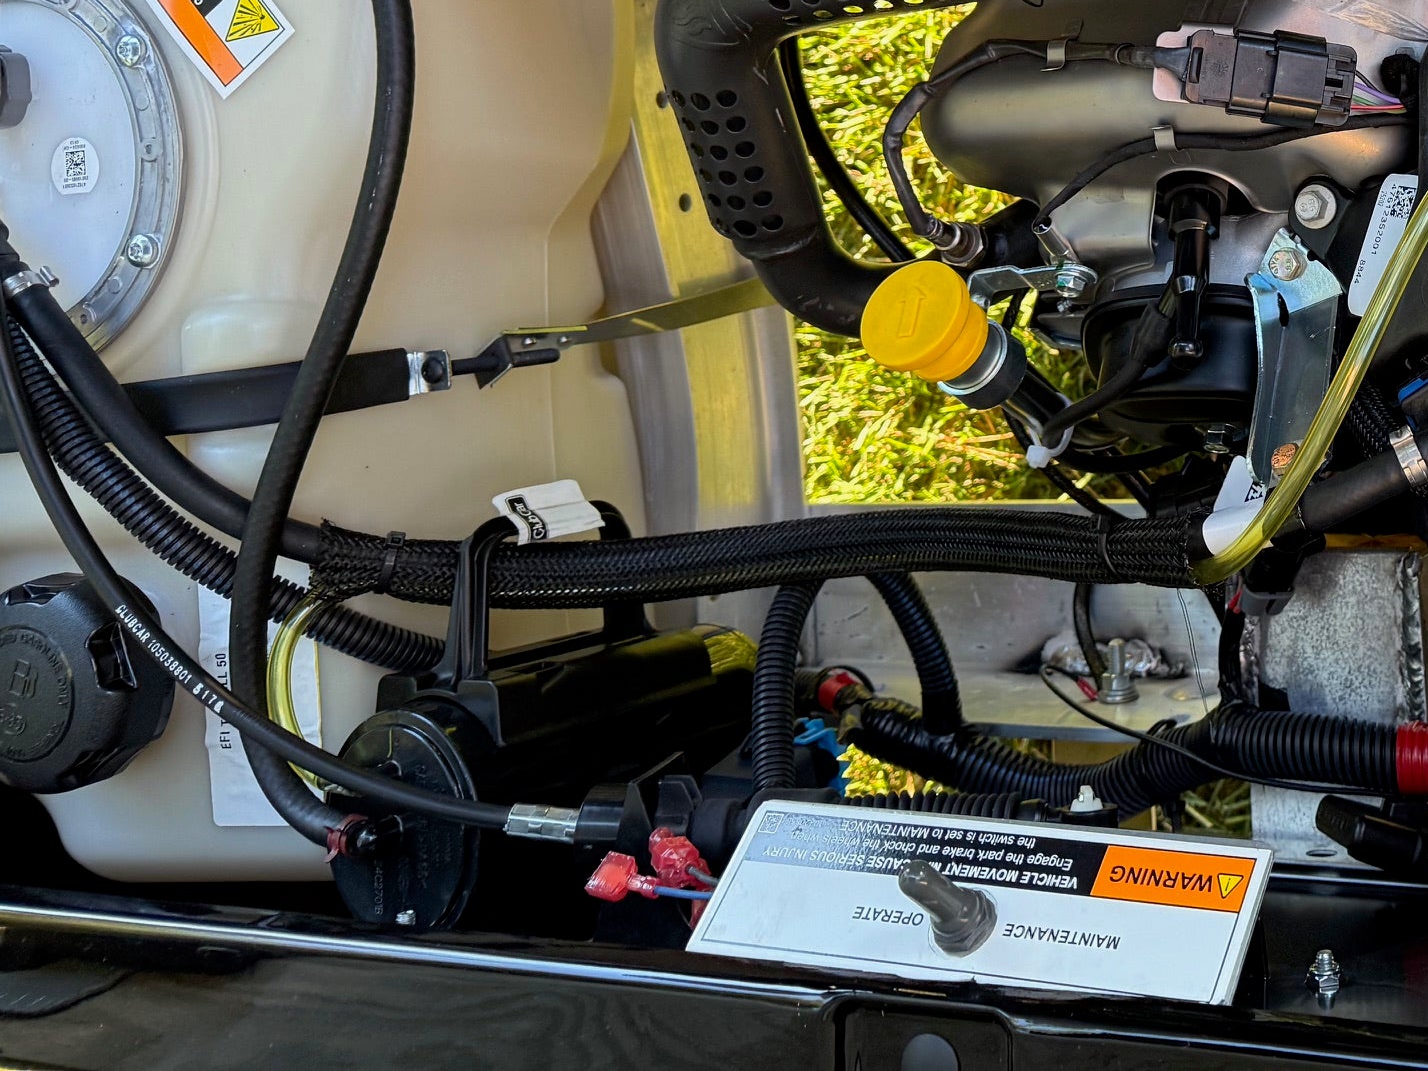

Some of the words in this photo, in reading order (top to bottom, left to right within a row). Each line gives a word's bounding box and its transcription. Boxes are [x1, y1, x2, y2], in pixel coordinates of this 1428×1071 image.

[1354, 259, 1366, 284] 8844
[115, 604, 149, 642] CLUBCAR
[148, 639, 192, 684] 105038801
[215, 653, 227, 667] 50
[219, 732, 232, 749] EFI
[838, 820, 929, 838] MAINTENANCE
[930, 828, 944, 839] to
[944, 830, 964, 841] set
[964, 831, 976, 843] is
[977, 833, 1015, 846] switch
[1016, 836, 1036, 848] the
[762, 845, 808, 859] INJURY
[806, 849, 865, 866] SERIOUS
[864, 855, 906, 870] CAUSE
[942, 863, 1019, 882] MOVEMENT
[1019, 871, 1078, 888] VEHICLE
[1108, 865, 1214, 892] WARNING
[851, 906, 925, 925] OPERATE
[1002, 923, 1120, 949] MAINTENANCE
